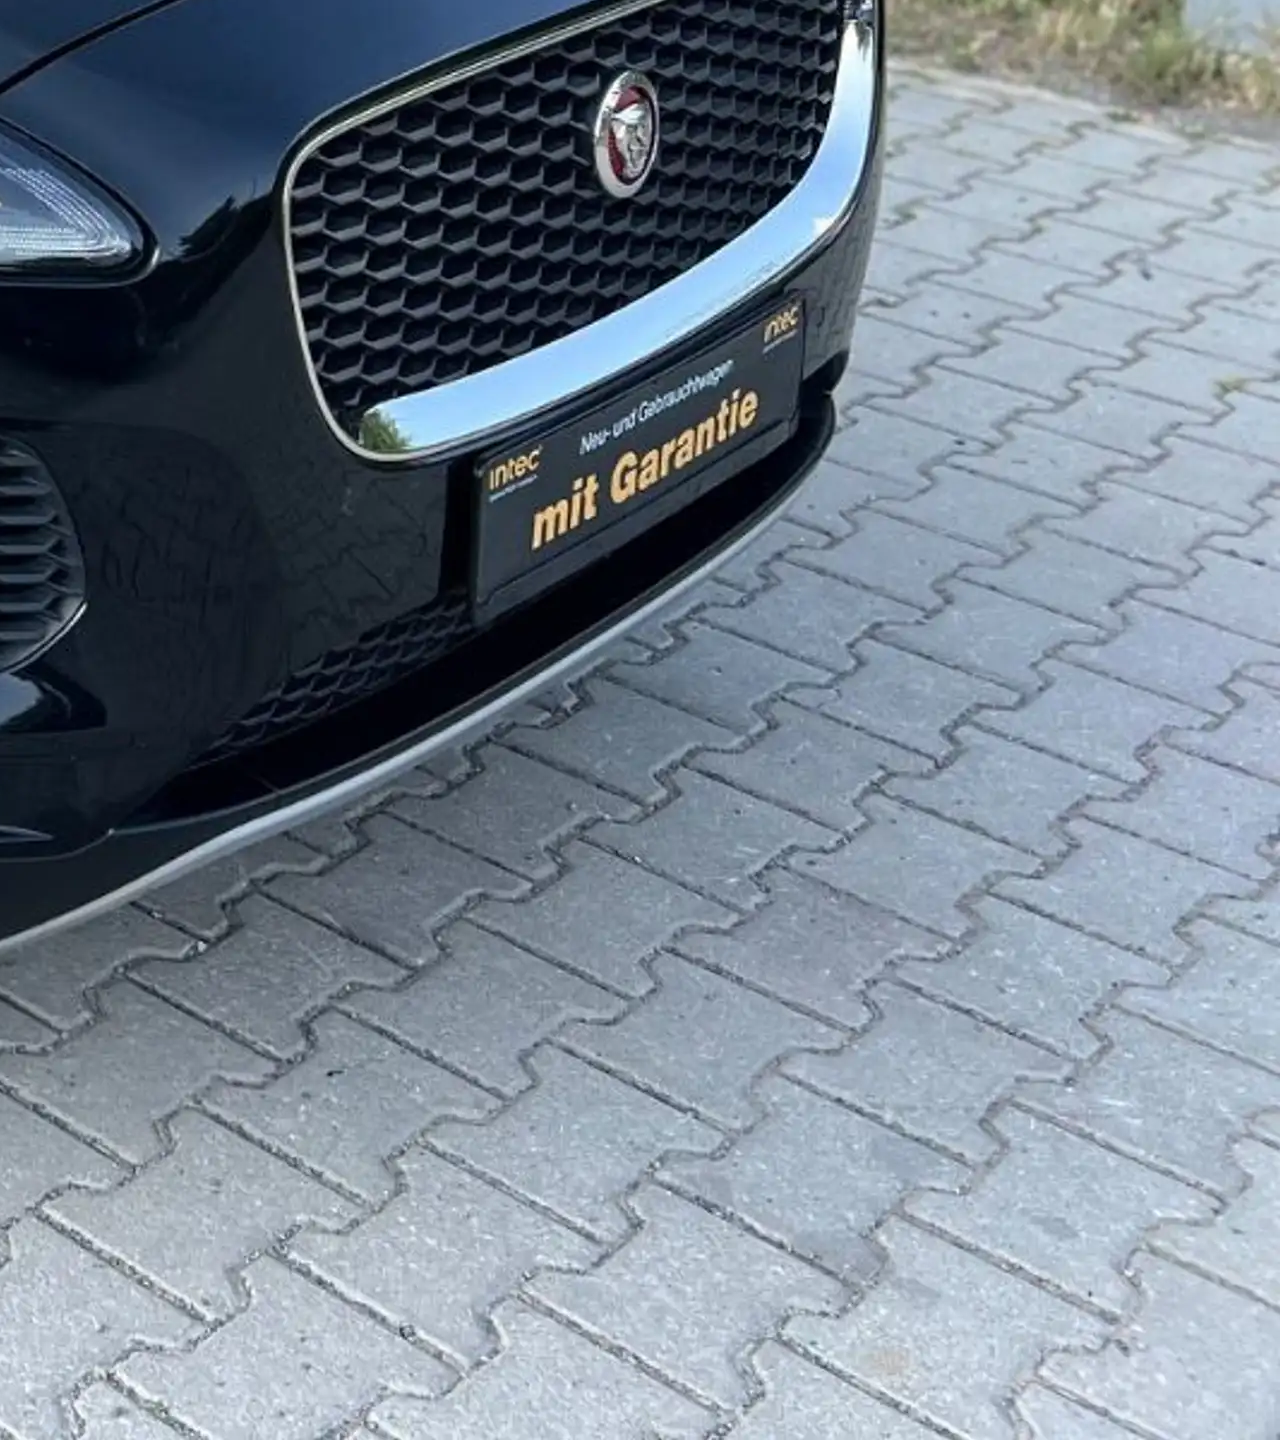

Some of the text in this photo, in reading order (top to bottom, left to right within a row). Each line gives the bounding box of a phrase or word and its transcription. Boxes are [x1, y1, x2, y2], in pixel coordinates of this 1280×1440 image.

[578, 428, 611, 456] Neu-
[612, 407, 637, 438] und
[489, 447, 541, 491] intec
[531, 388, 759, 551] mit Garantie
